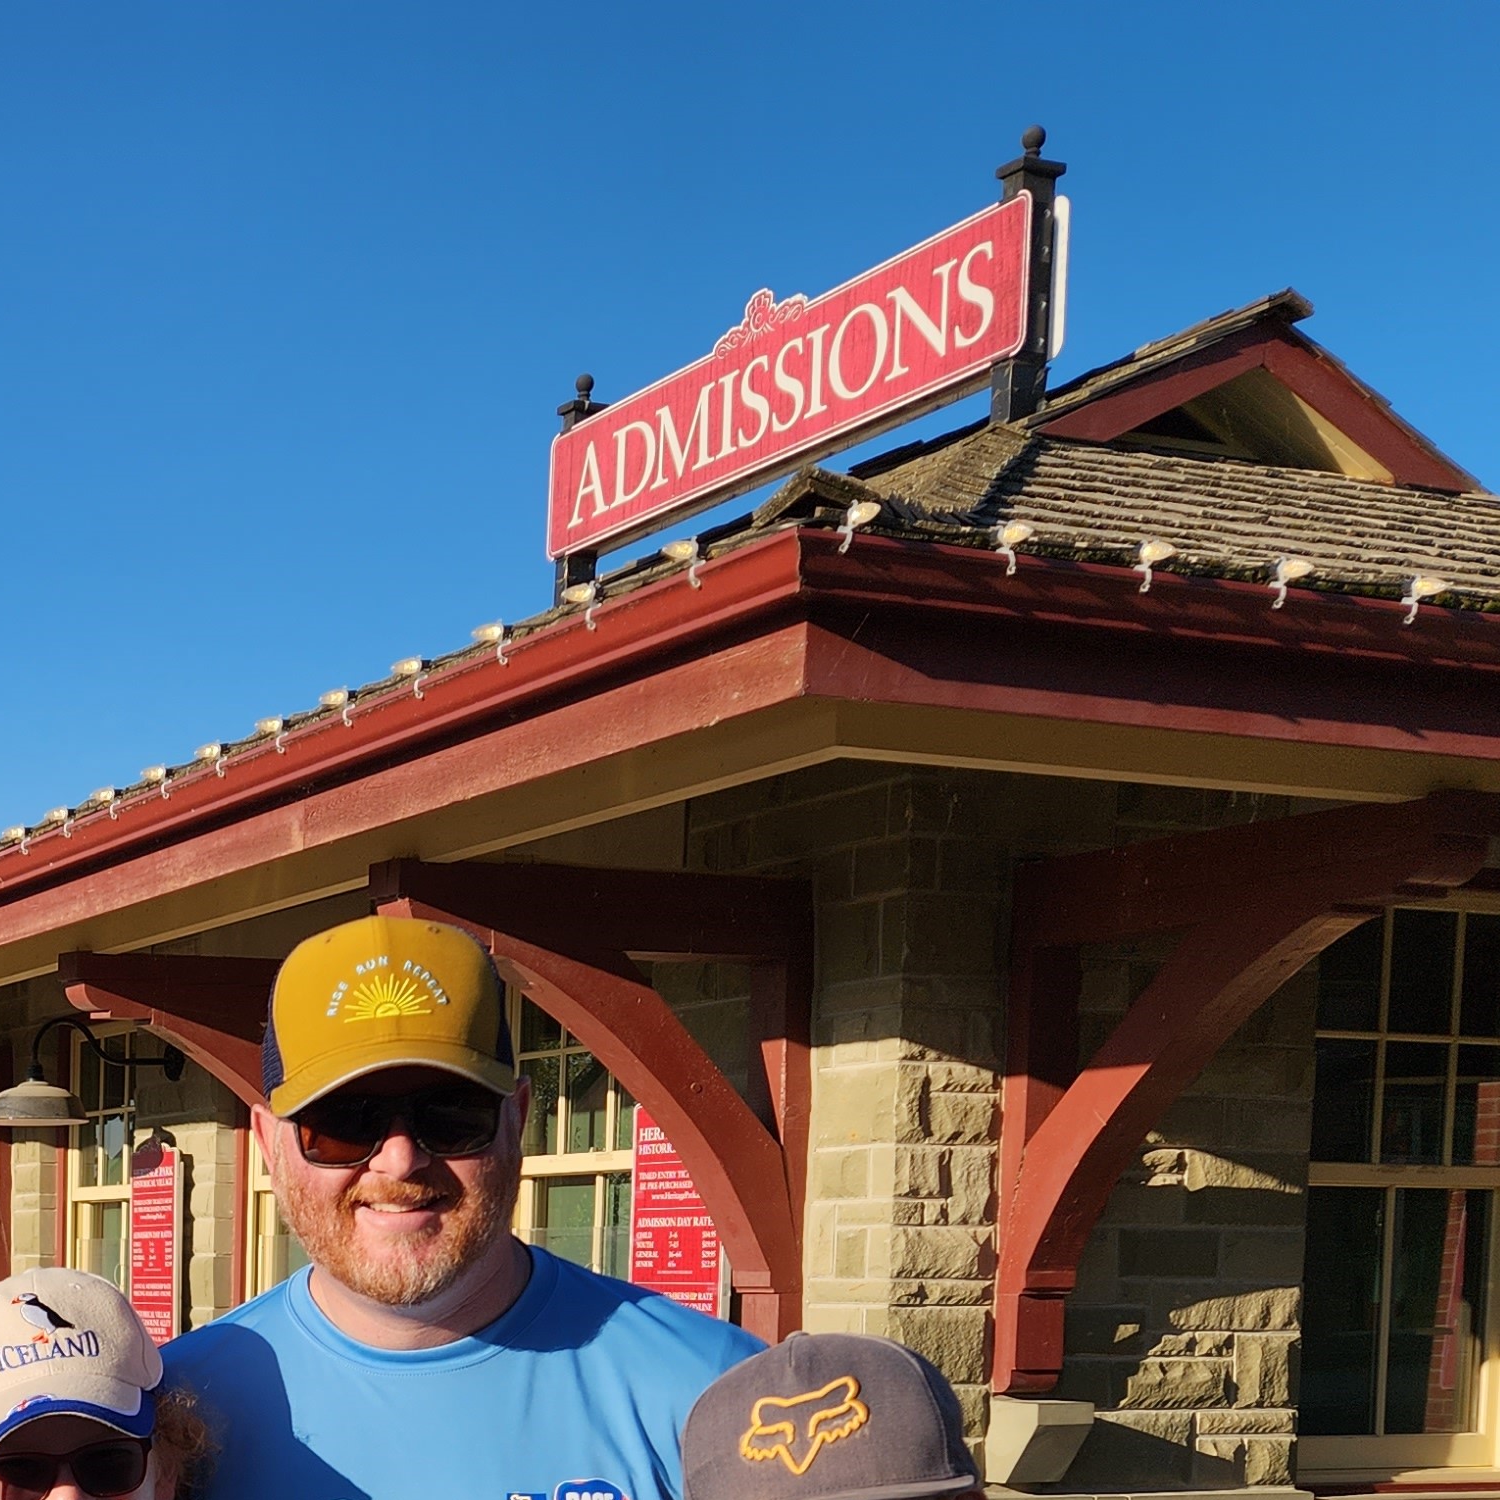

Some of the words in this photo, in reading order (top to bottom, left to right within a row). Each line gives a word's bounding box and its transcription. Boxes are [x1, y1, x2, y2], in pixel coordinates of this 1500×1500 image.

[566, 241, 994, 529] ADMISSIONS
[326, 981, 349, 1017] RISE
[355, 955, 389, 976] RUN
[403, 959, 450, 1006] REPEAT
[639, 1127, 665, 1142] HERI
[636, 1217, 676, 1228] ADMISSION
[677, 1217, 693, 1227] DAY
[693, 1216, 714, 1226] RATE
[698, 1292, 713, 1300] RATE
